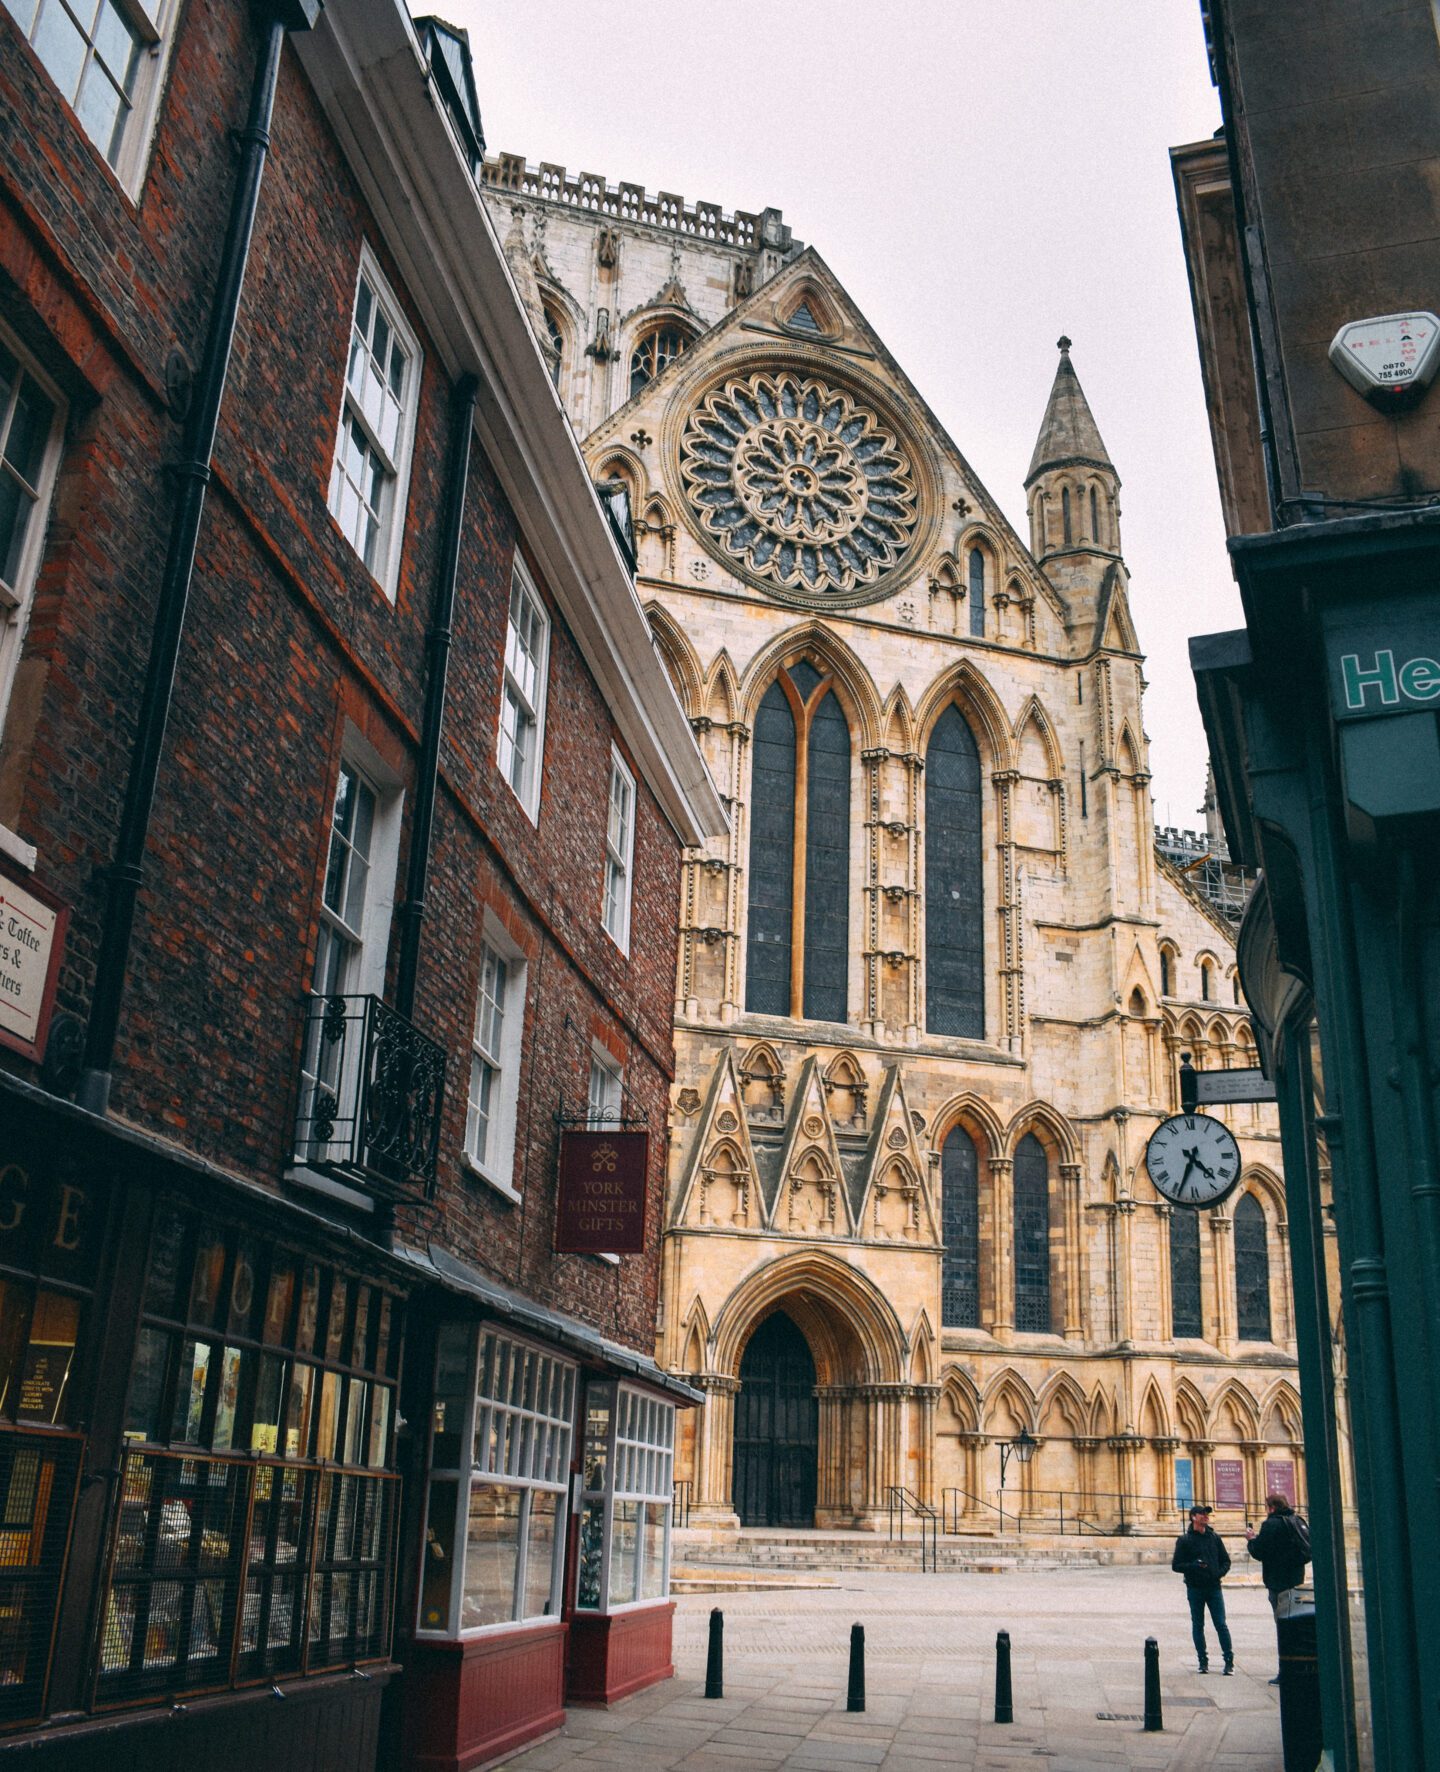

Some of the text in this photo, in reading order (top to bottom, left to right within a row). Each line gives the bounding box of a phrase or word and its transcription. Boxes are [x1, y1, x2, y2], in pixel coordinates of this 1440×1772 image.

[1400, 321, 1417, 362] ALARMS
[1383, 361, 1406, 370] 0870
[1378, 368, 1413, 379] 755 4900
[1341, 649, 1440, 709] He
[8, 917, 40, 952] Toffee
[12, 949, 22, 969] &
[583, 1181, 625, 1196] YORK
[567, 1199, 639, 1214] MINSTER
[578, 1217, 625, 1232] GIFTS
